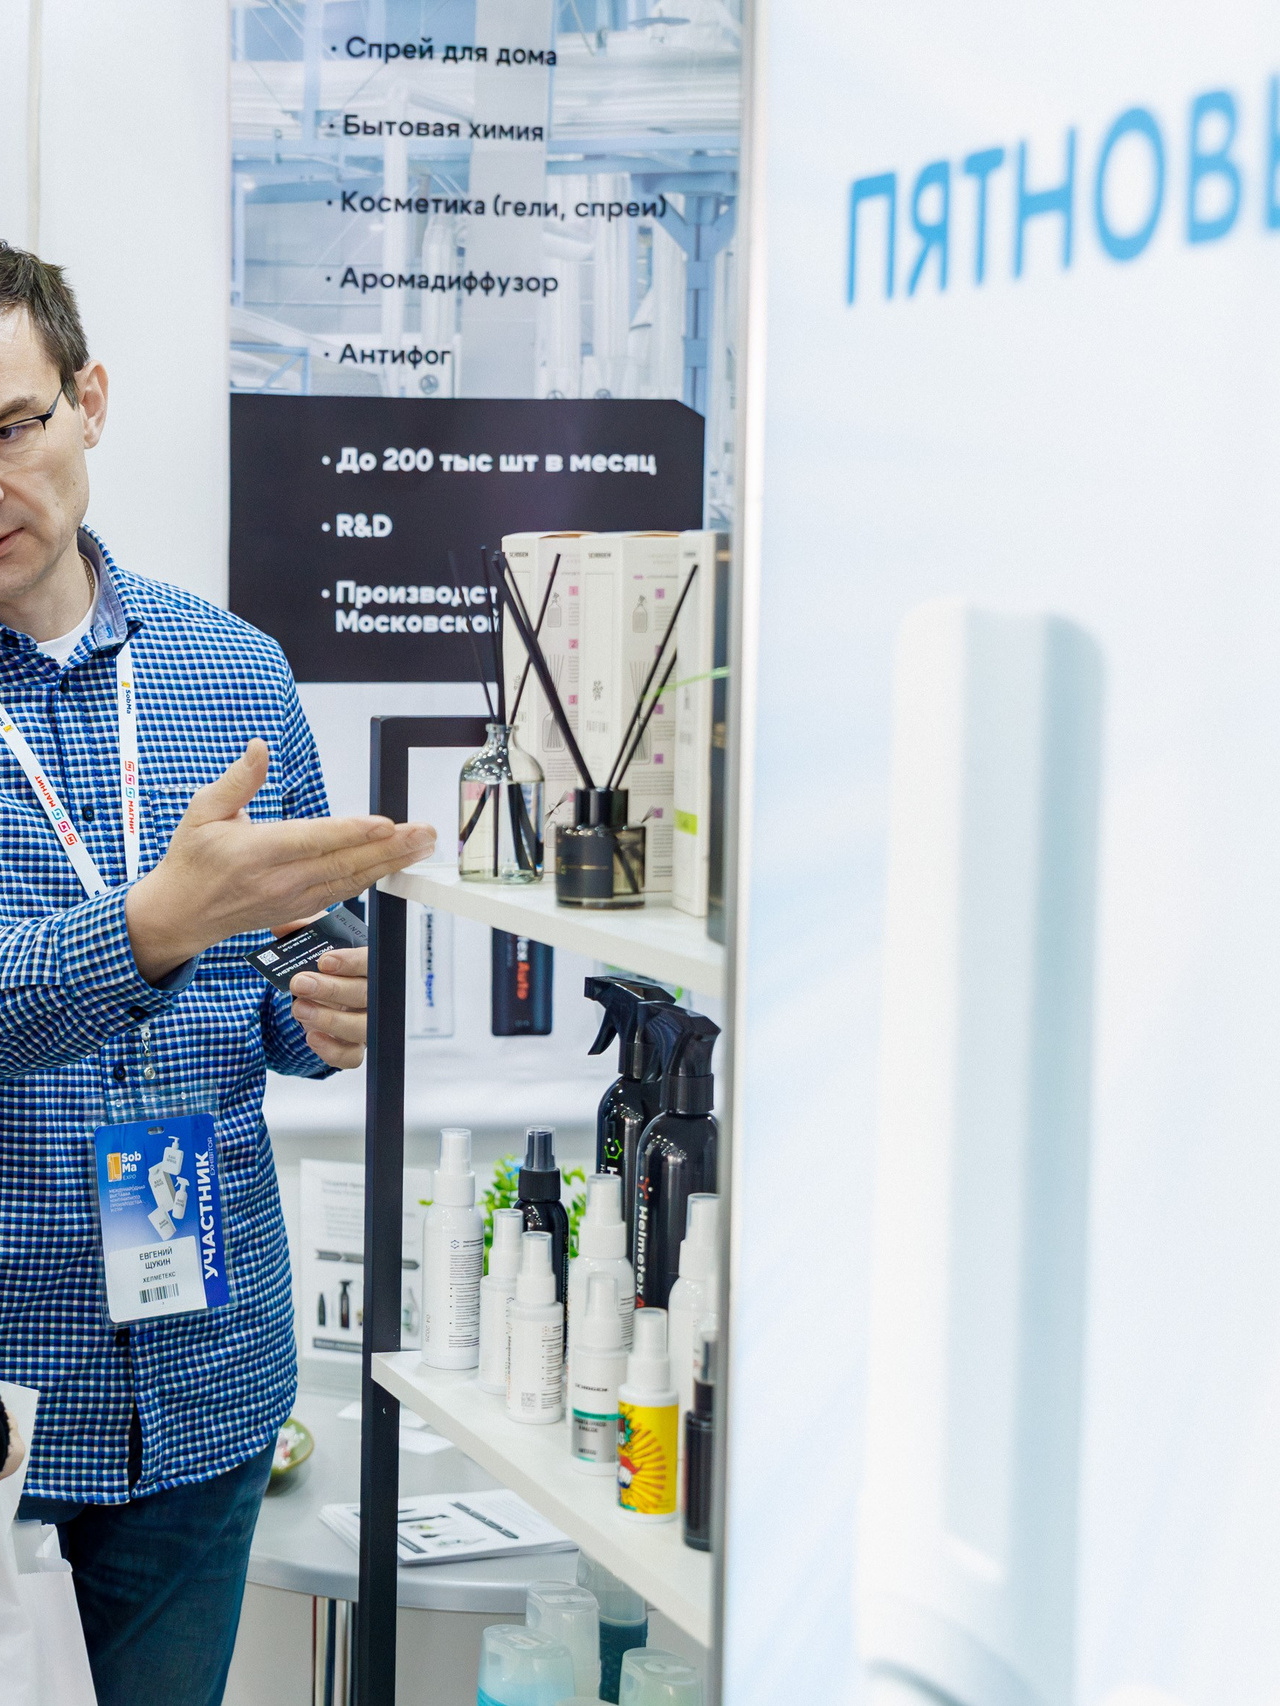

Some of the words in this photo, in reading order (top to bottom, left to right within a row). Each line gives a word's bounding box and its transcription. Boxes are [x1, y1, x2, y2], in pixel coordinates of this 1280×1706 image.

[345, 36, 434, 62] Спрей
[442, 43, 488, 64] для
[496, 46, 558, 67] дома
[343, 114, 460, 138] Бытовая
[469, 120, 543, 141] химия
[341, 191, 486, 216] Косметика
[493, 195, 566, 220] (гели,
[575, 195, 668, 220] спреи)
[340, 268, 560, 296] Аромадиффузор
[339, 344, 452, 369] Антифог
[335, 448, 377, 474] До
[383, 449, 433, 472] 200
[439, 453, 493, 473] тыс
[499, 454, 539, 474] шт
[545, 455, 563, 472] в
[570, 455, 657, 476] месяц
[335, 514, 393, 539] R&D
[35, 775, 56, 808] МАГНИТ
[335, 914, 368, 938] KALINOF
[517, 961, 530, 1000] Auto
[122, 1151, 142, 1163] Sob
[122, 1163, 137, 1173] Ma
[195, 1151, 218, 1279] УЧАСТНИК
[139, 1246, 173, 1261] ЕВГЕНИЙ
[145, 1258, 171, 1270] ЩУКИН
[636, 1205, 648, 1296] Helmetex
